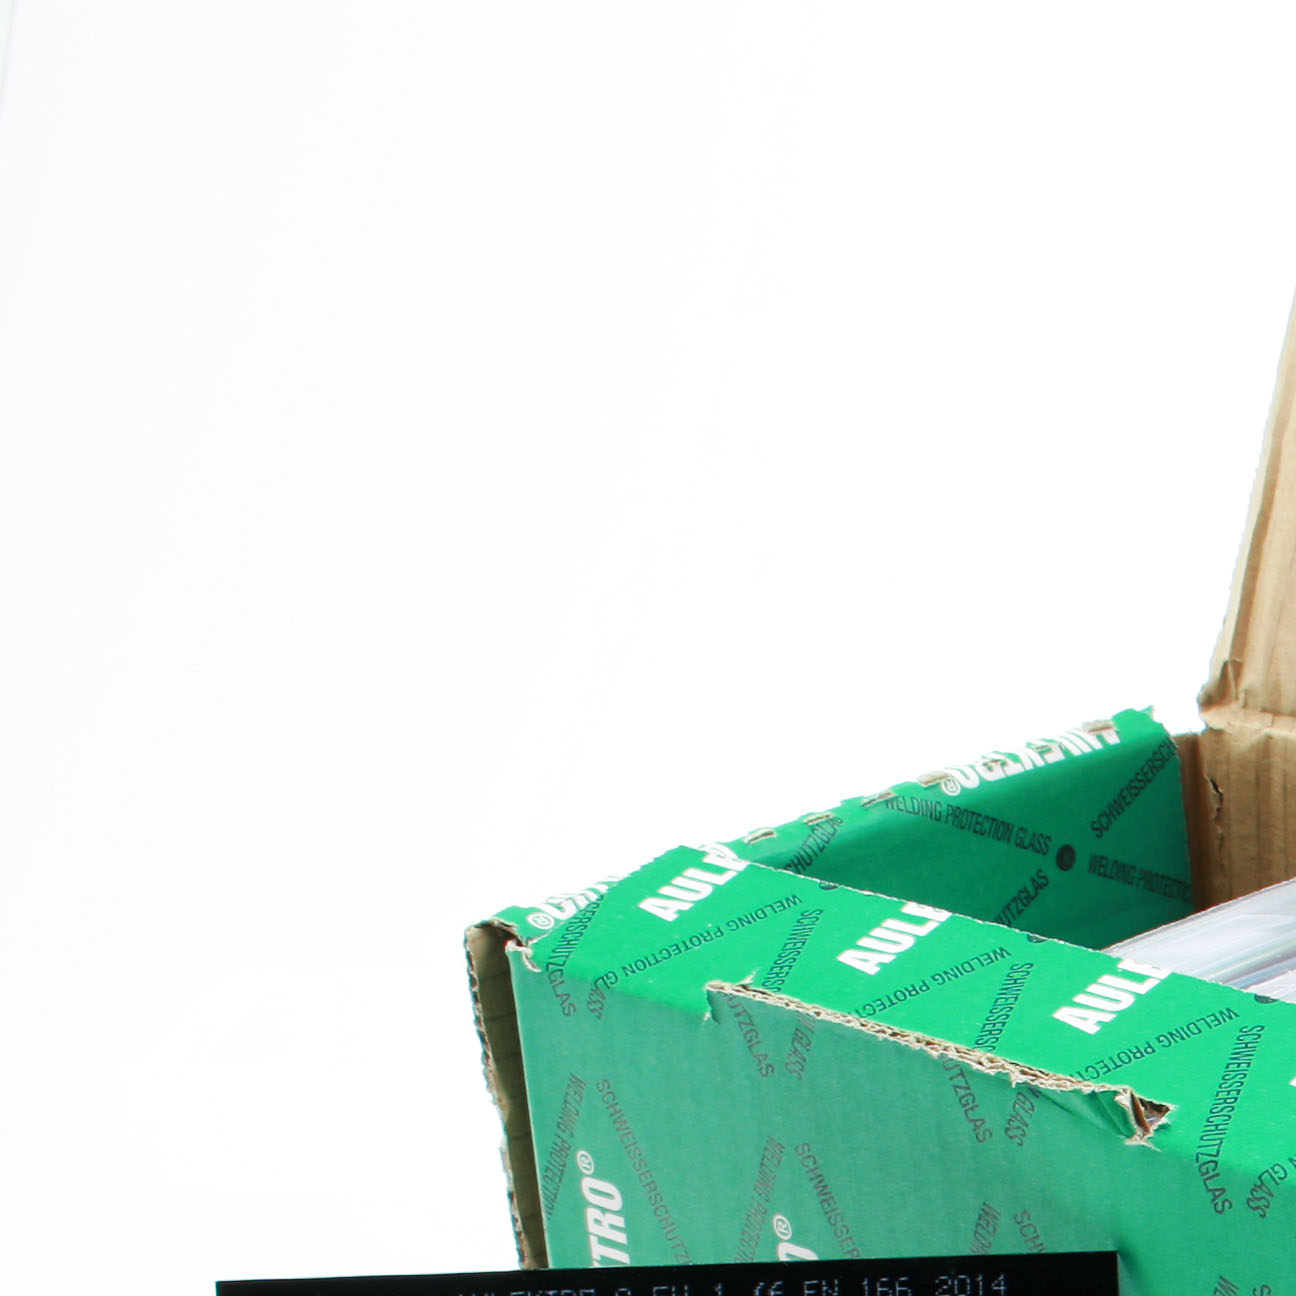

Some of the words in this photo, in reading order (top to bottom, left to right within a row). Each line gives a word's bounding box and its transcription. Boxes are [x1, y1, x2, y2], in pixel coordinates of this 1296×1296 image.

[945, 804, 1014, 843] PROTECTION
[1015, 827, 1052, 856] GLASS
[726, 895, 802, 931] WELDING
[622, 927, 724, 976] PROTECTION
[931, 947, 1011, 985] WELDING
[587, 971, 618, 1019] GLASS
[1156, 1008, 1239, 1047] WELDING
[784, 1027, 812, 1081] GLASS
[556, 1073, 586, 1138] WELDING
[1007, 1091, 1036, 1147] GLASS
[1195, 1025, 1265, 1215] SCHWEISSERSCHUTZGLAS
[1246, 1164, 1288, 1219] GLASS
